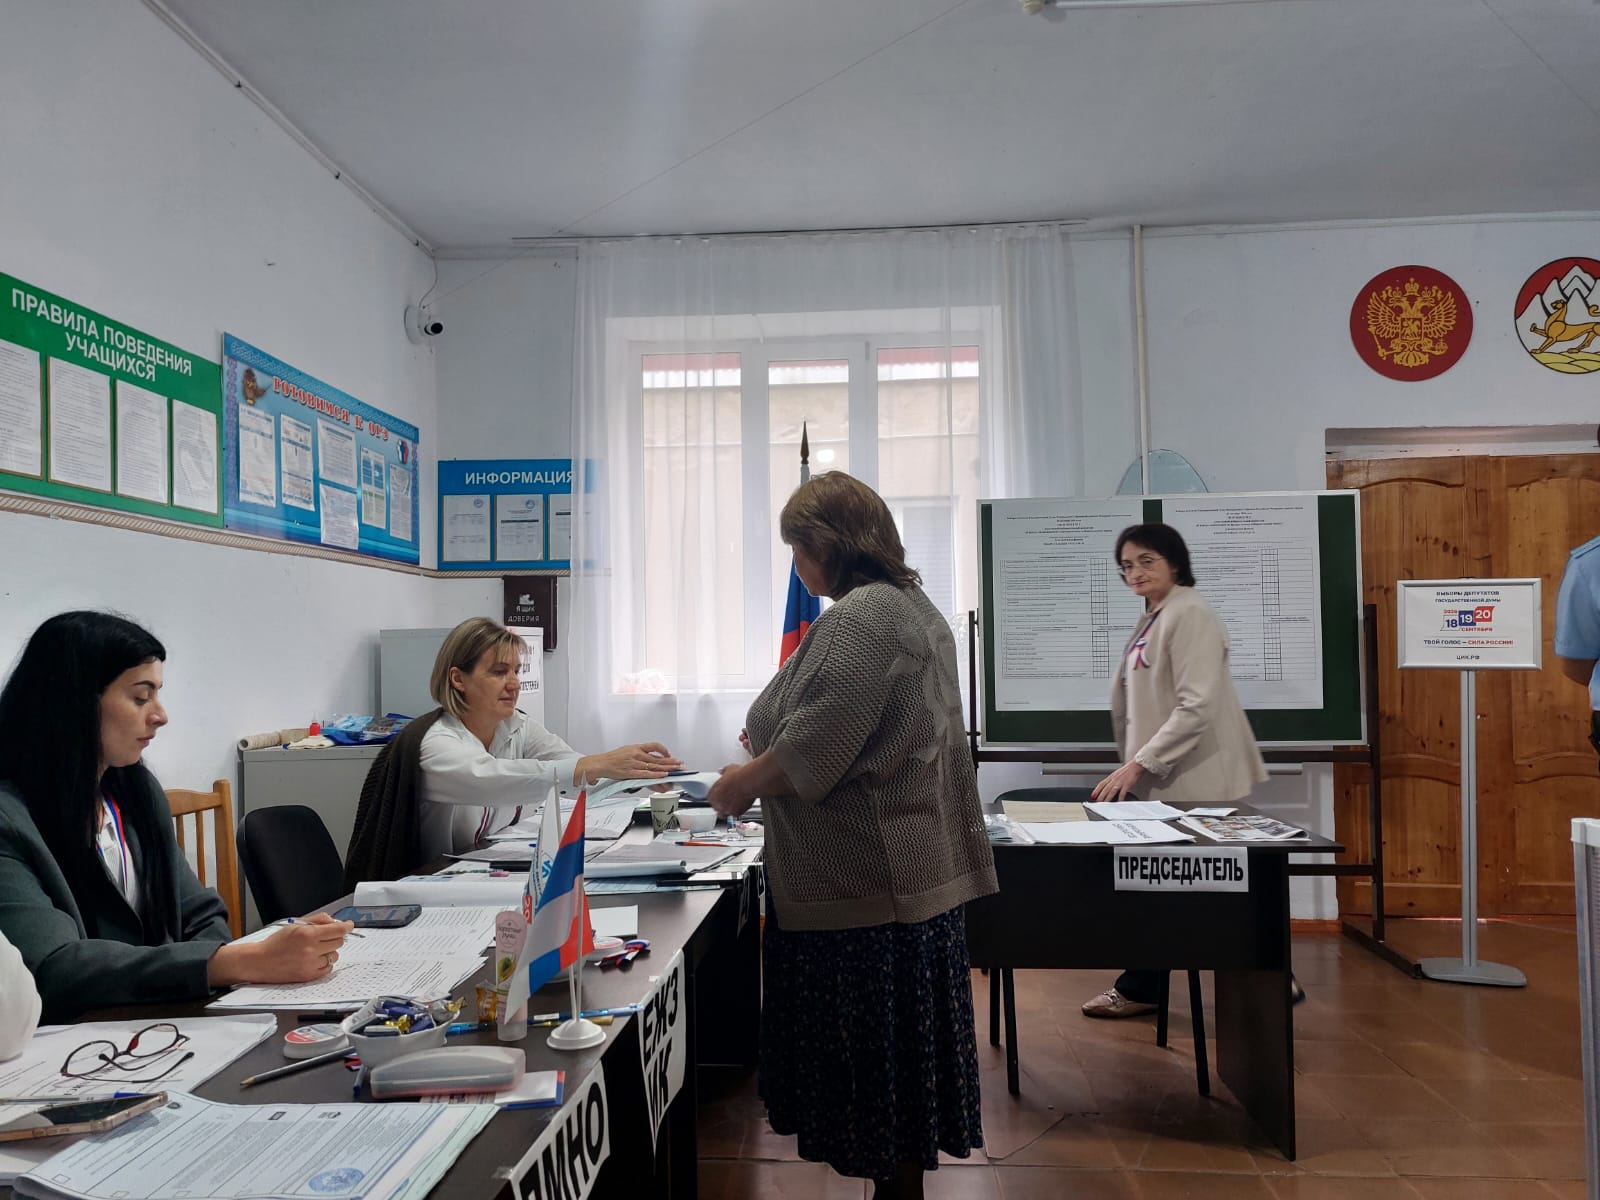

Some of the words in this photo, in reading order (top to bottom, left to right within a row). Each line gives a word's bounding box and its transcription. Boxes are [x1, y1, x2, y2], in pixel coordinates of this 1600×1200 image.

[12, 287, 99, 339] ПРАВИЛА
[103, 324, 192, 376] ПОВЕДЕНИЯ
[65, 331, 156, 382] УЧАЩИХСЯ
[273, 376, 350, 425] ГОТОВИМСЯ
[355, 414, 363, 430] К
[465, 471, 575, 485] ИНФОРМАЦИЯ
[508, 615, 540, 623] ДОВЕРИЯ
[1446, 619, 1458, 628] 18
[1460, 614, 1472, 623] 19
[1475, 610, 1490, 619] 20
[1119, 856, 1244, 885] ПРЕДСЕДАТЕЛЬ
[643, 967, 678, 1071] ЕЖЗ
[648, 1037, 672, 1134] ИК
